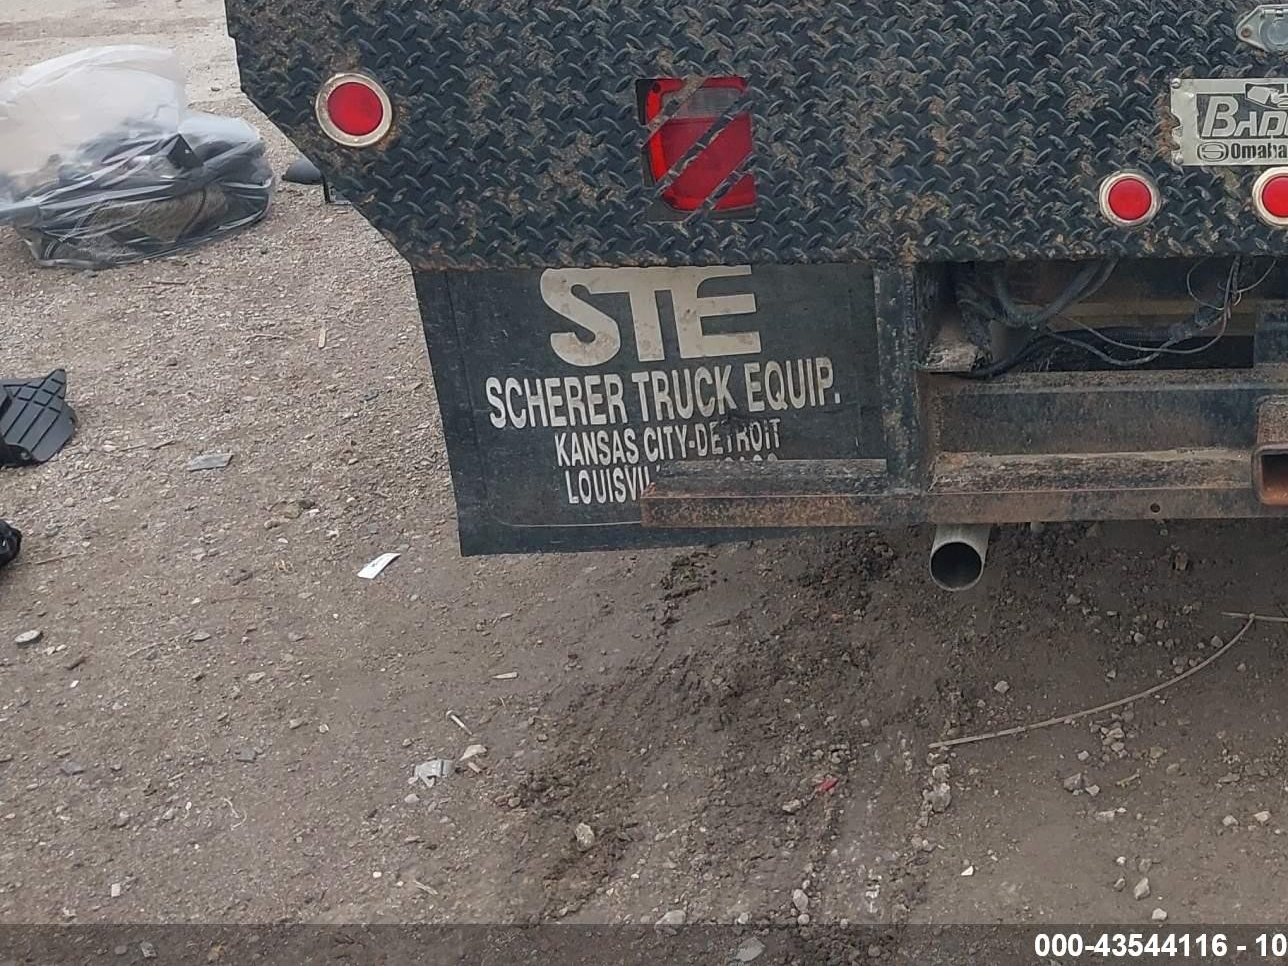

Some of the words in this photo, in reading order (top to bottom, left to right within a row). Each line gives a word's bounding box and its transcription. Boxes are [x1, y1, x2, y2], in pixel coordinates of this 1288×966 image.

[1231, 142, 1288, 159] Omaha
[540, 265, 762, 367] STE
[485, 374, 629, 429] SCHERER
[631, 365, 738, 422] TRUCK
[743, 356, 841, 412] EQUIP.
[554, 428, 640, 467] KANSAS
[643, 418, 781, 463] CITY-DETROIT
